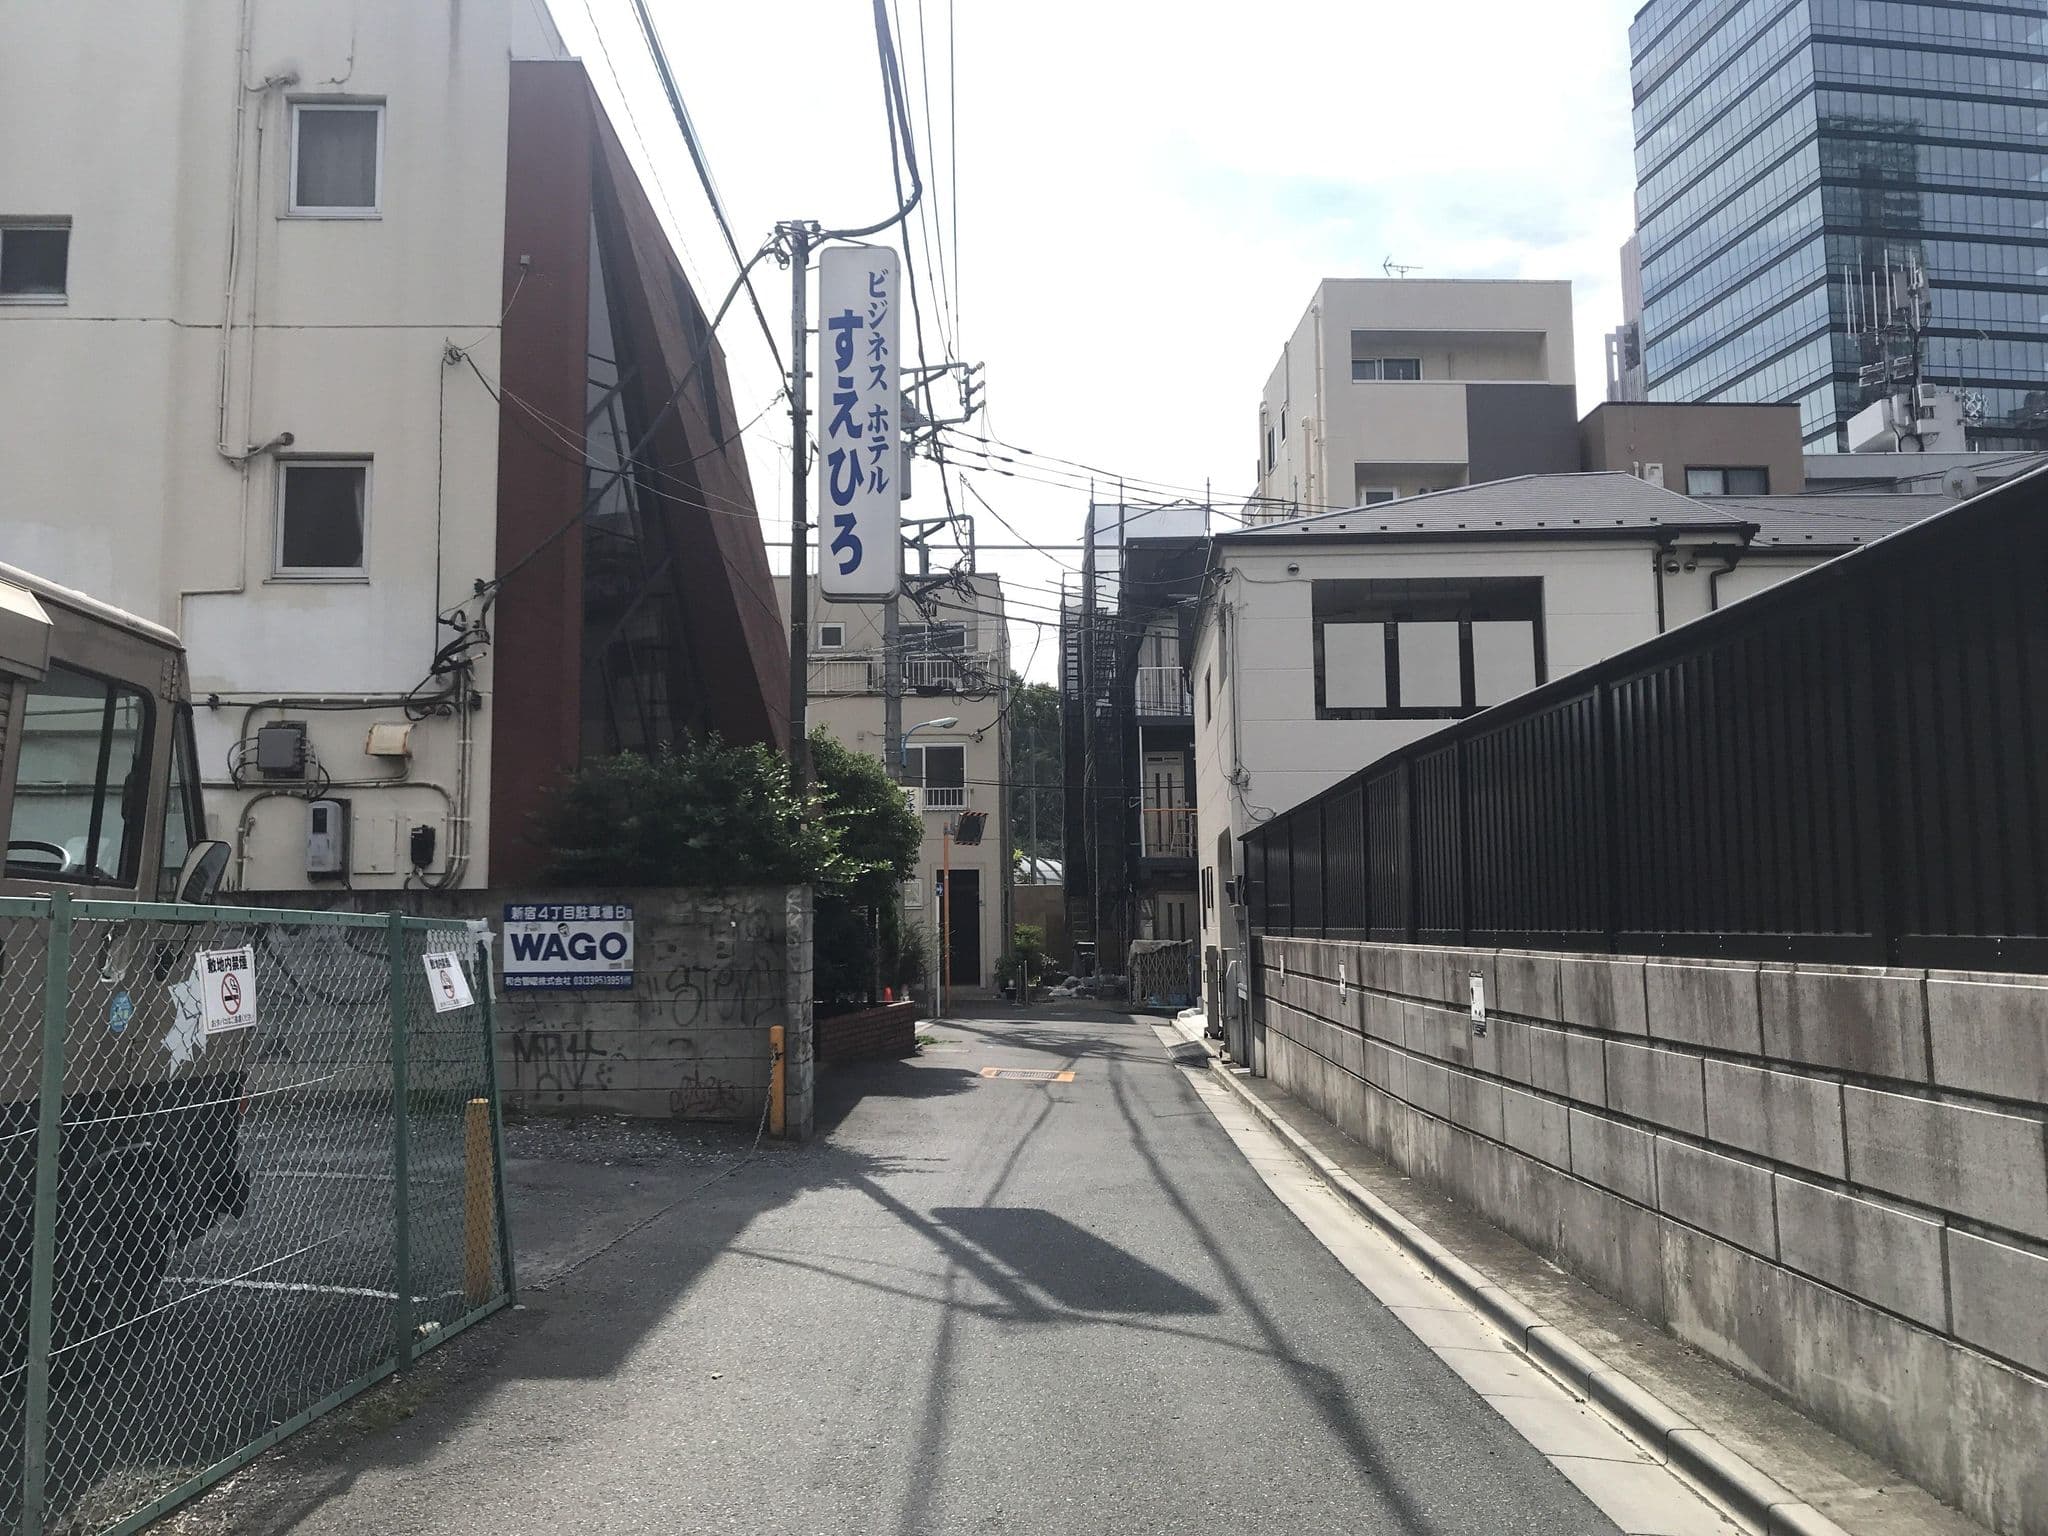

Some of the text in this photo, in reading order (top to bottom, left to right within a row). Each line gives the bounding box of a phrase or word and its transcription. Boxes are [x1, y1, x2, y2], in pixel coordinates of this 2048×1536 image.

[828, 309, 864, 575] すえひろ
[510, 932, 627, 961] WAGO
[207, 955, 249, 973] 敷地内禁煙
